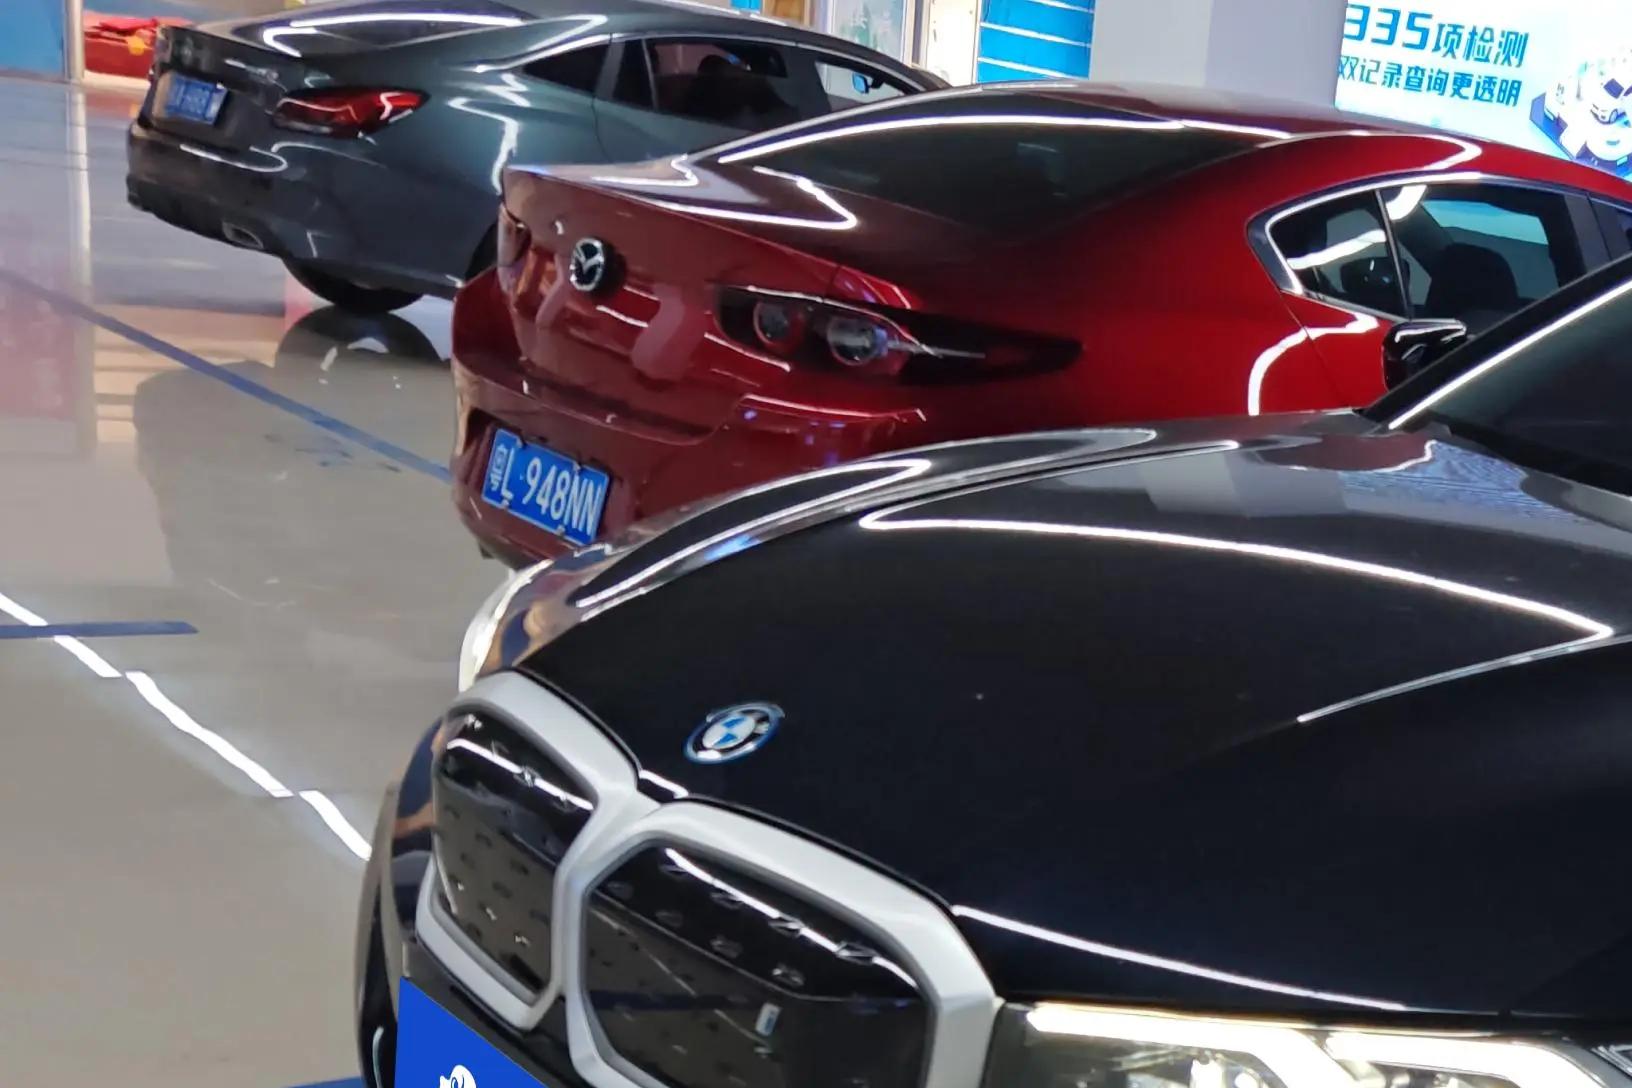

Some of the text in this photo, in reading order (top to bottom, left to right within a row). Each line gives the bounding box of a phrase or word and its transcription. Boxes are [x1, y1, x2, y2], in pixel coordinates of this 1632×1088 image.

[1343, 4, 1529, 68] 335项检测
[1338, 54, 1523, 107] 双记录查询更透明
